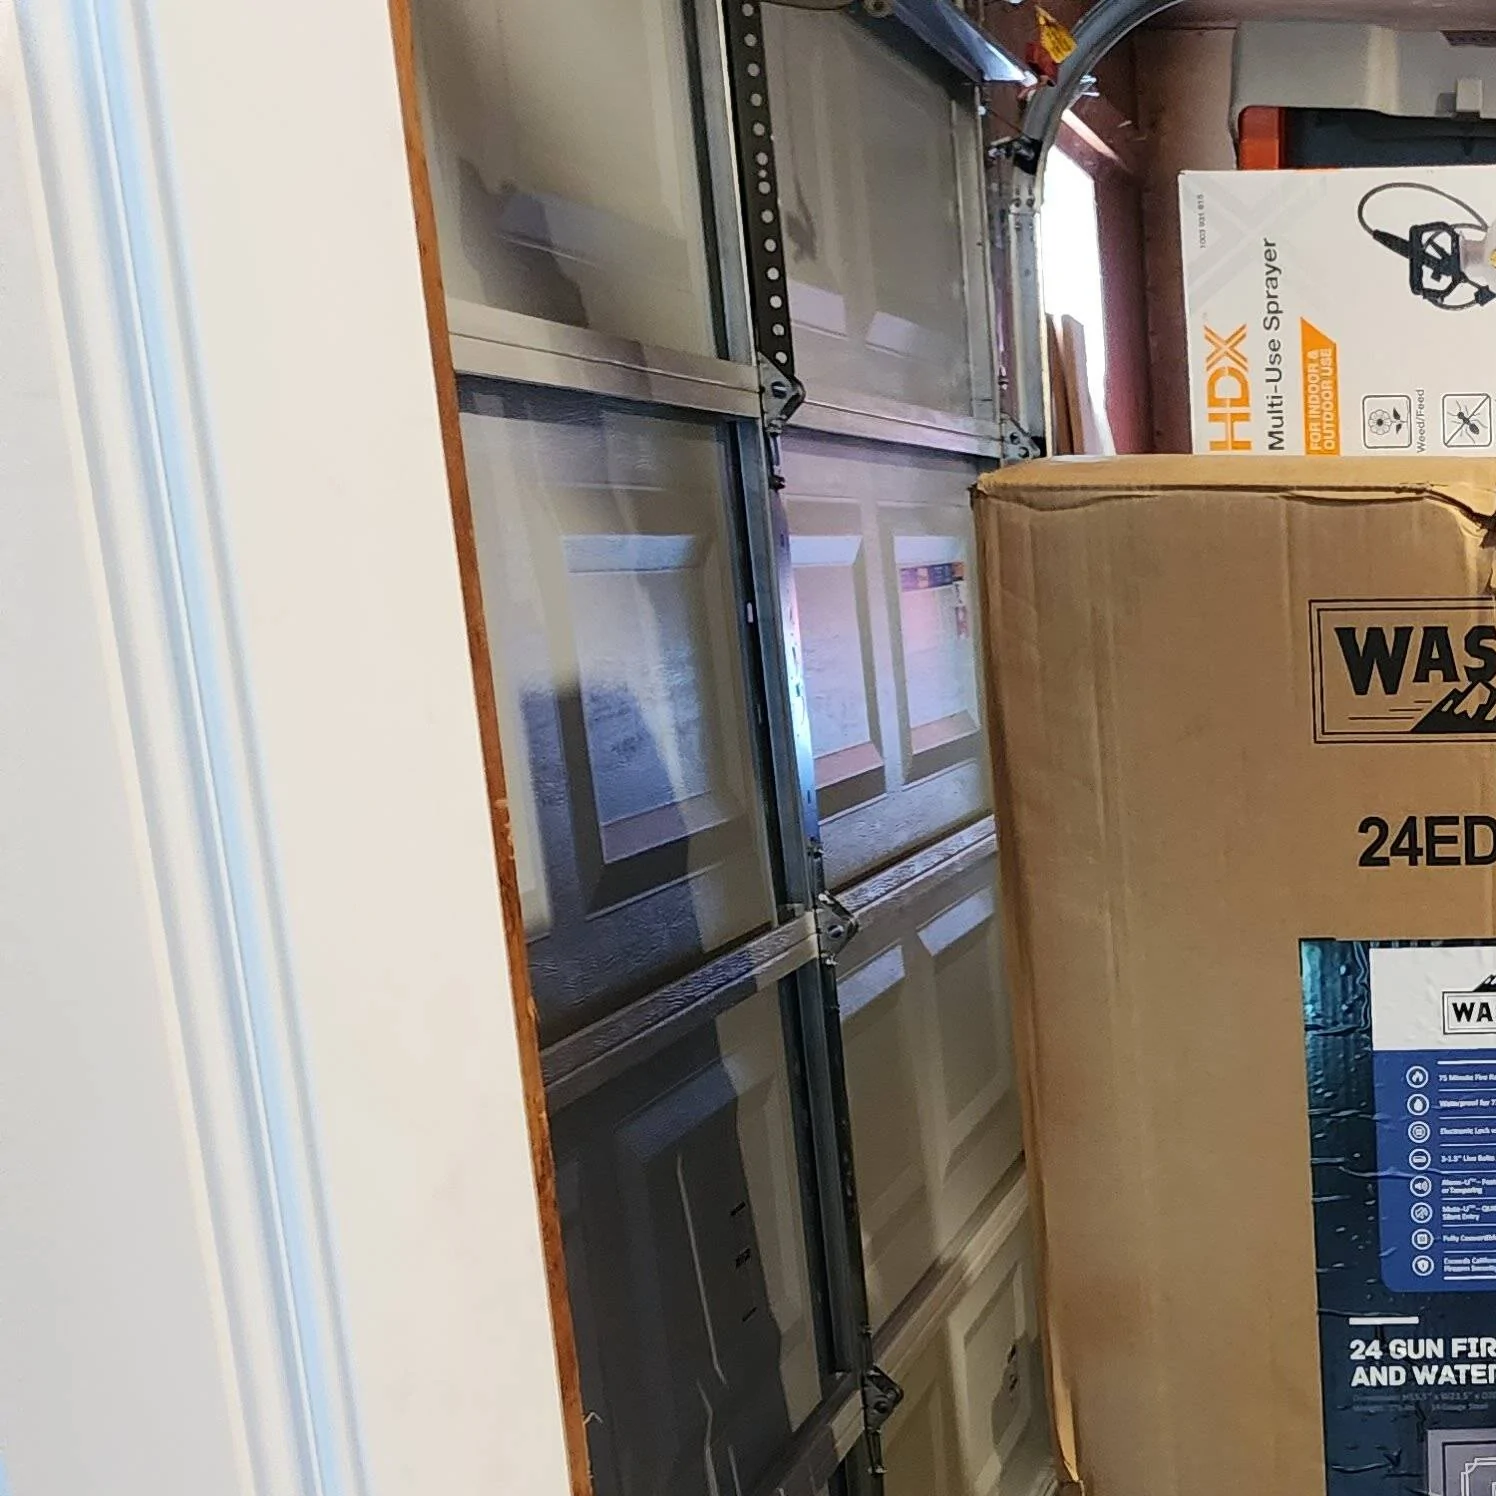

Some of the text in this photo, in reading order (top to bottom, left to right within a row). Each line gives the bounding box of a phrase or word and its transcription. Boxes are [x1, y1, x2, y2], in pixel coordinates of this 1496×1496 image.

[1203, 323, 1252, 452] HDX
[1263, 237, 1285, 451] Multi-Use Sprayer
[1307, 350, 1321, 451] FOR INDOOR &
[1320, 348, 1336, 450] OUTDOOR USE
[1416, 389, 1426, 453] Weed/Feed
[1350, 1339, 1383, 1360] 24
[1388, 1338, 1444, 1360] GUN
[1351, 1365, 1407, 1387] AND
